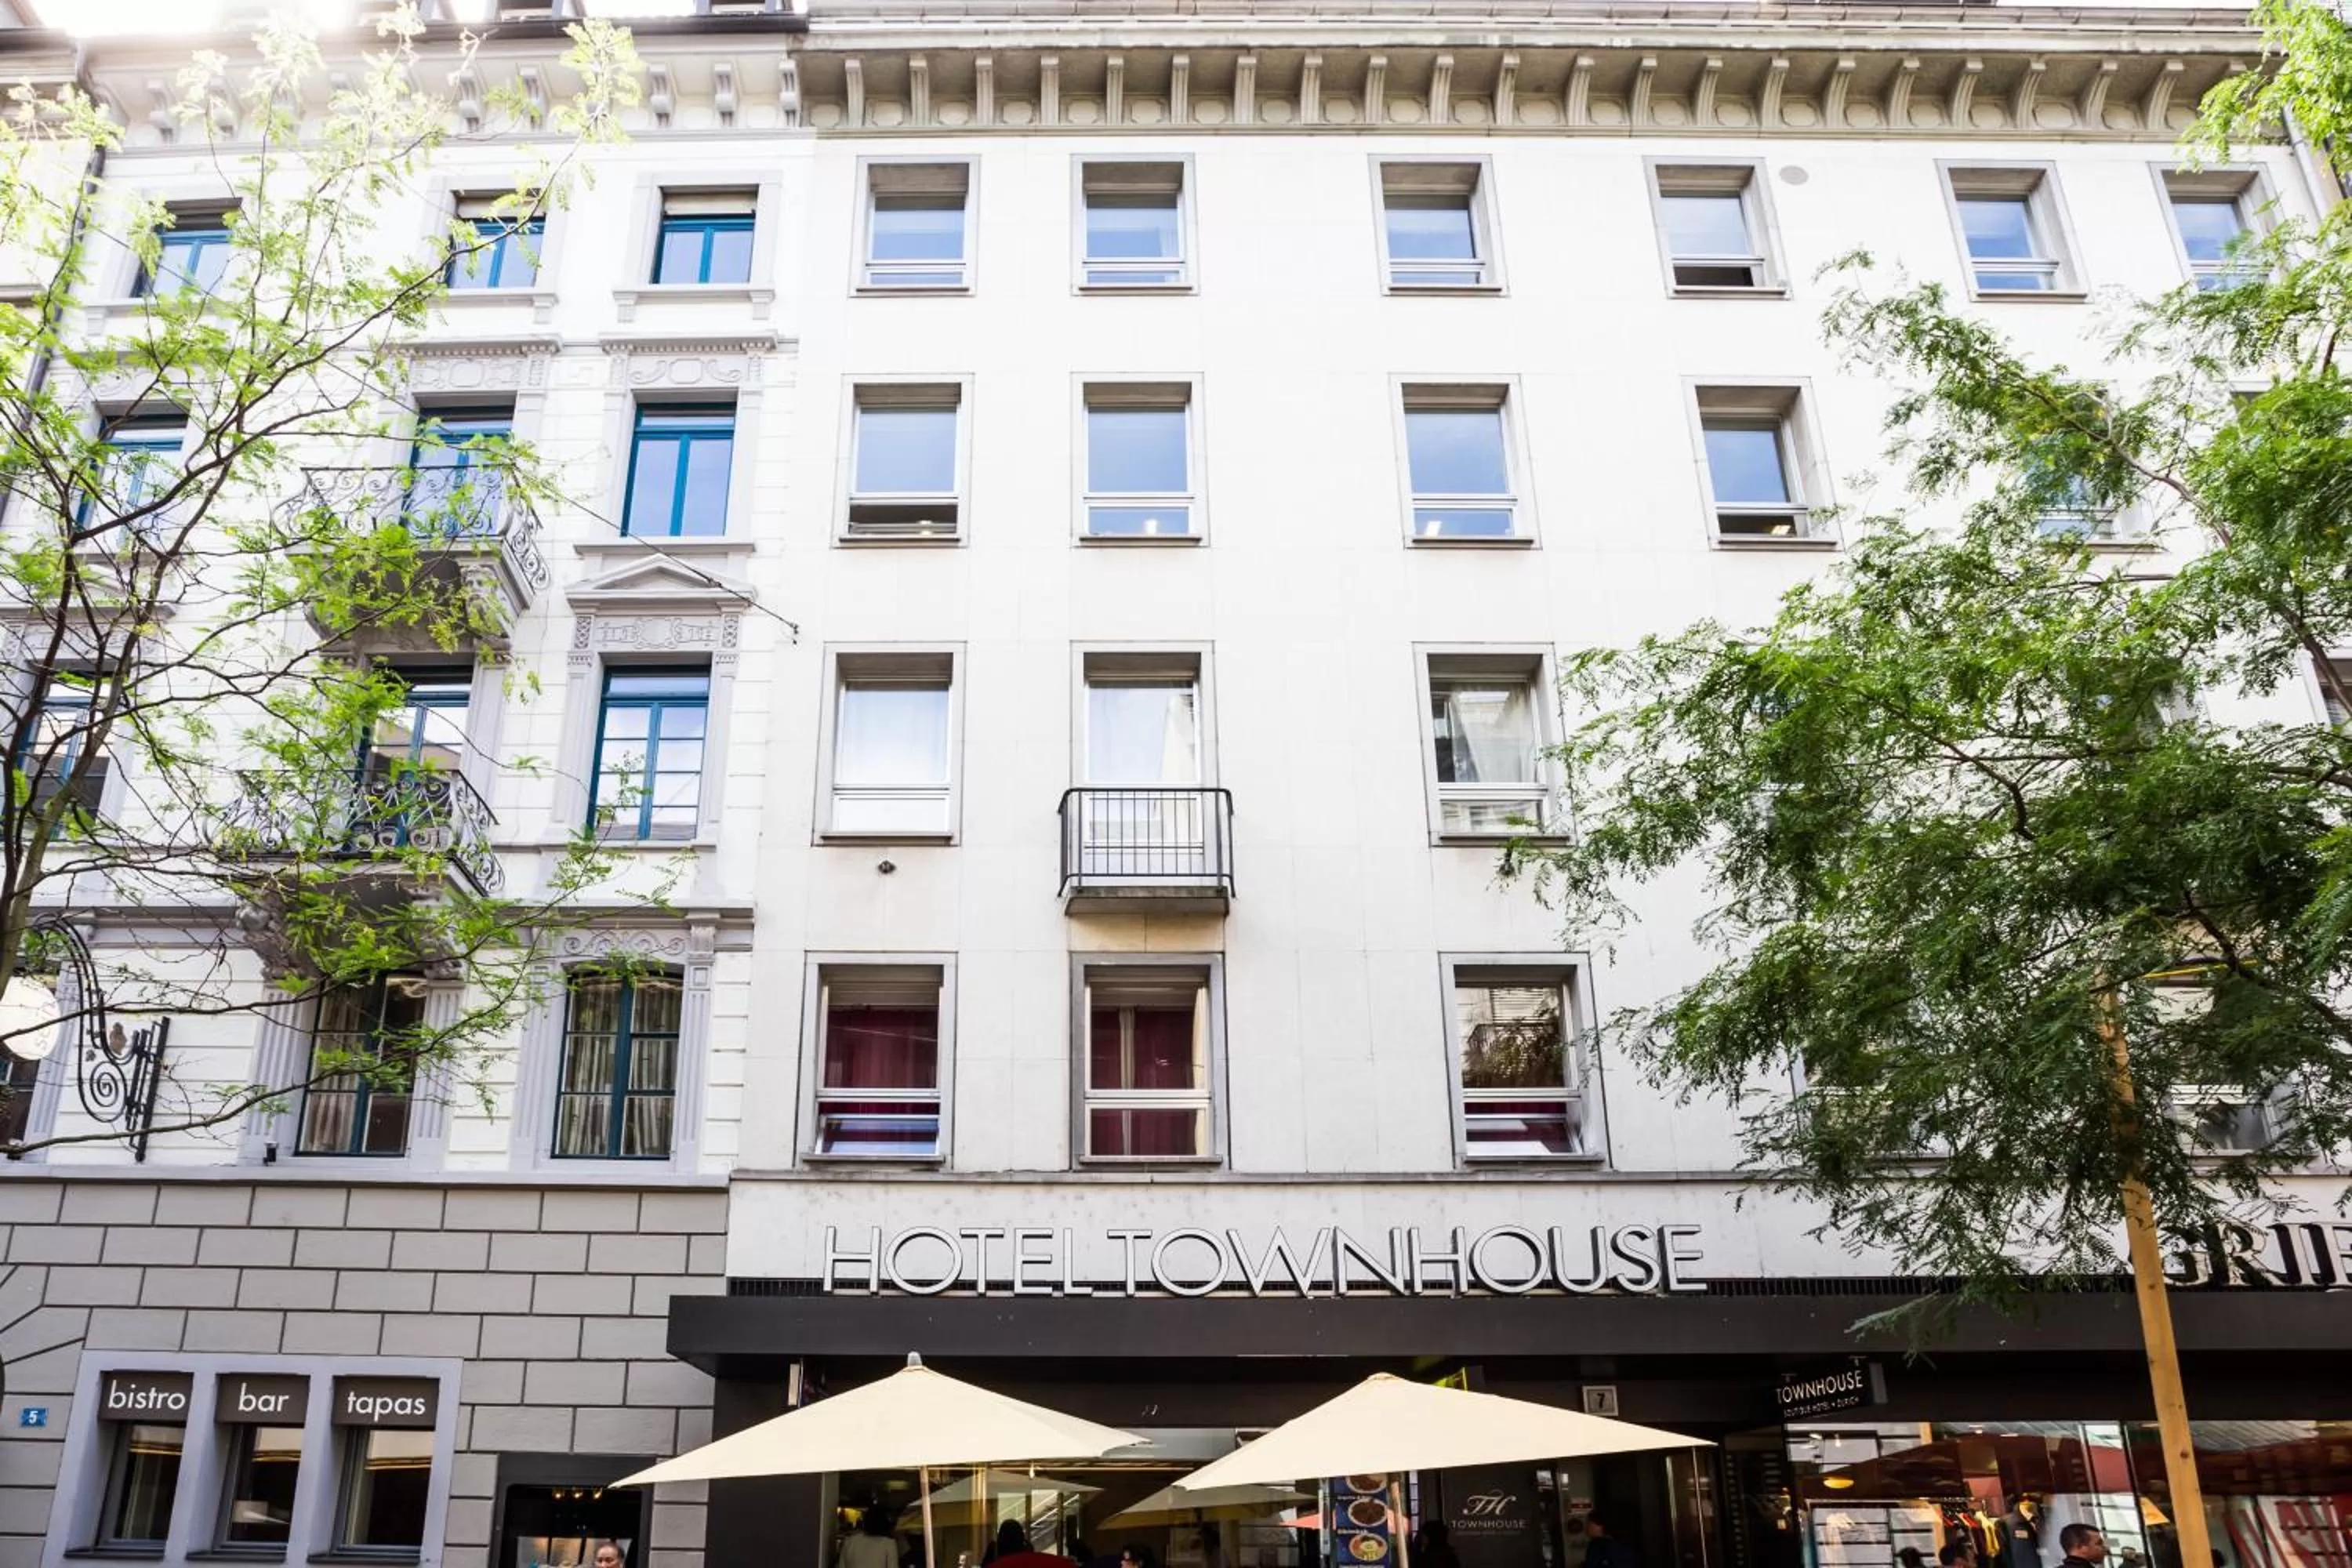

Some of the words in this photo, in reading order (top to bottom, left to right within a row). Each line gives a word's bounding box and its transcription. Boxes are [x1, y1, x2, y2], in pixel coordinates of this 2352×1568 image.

[823, 1225, 1093, 1294] HOTEL
[1107, 1224, 1708, 1295] TOWNHOUSE
[107, 1380, 186, 1410] bistro
[238, 1382, 289, 1413] bar
[1595, 1392, 1606, 1409] 7
[1776, 1370, 1864, 1404] TOWNHOUSE
[28, 1410, 38, 1425] 5
[347, 1391, 426, 1423] tapas
[1451, 1519, 1527, 1530] TOWNHOUSE
